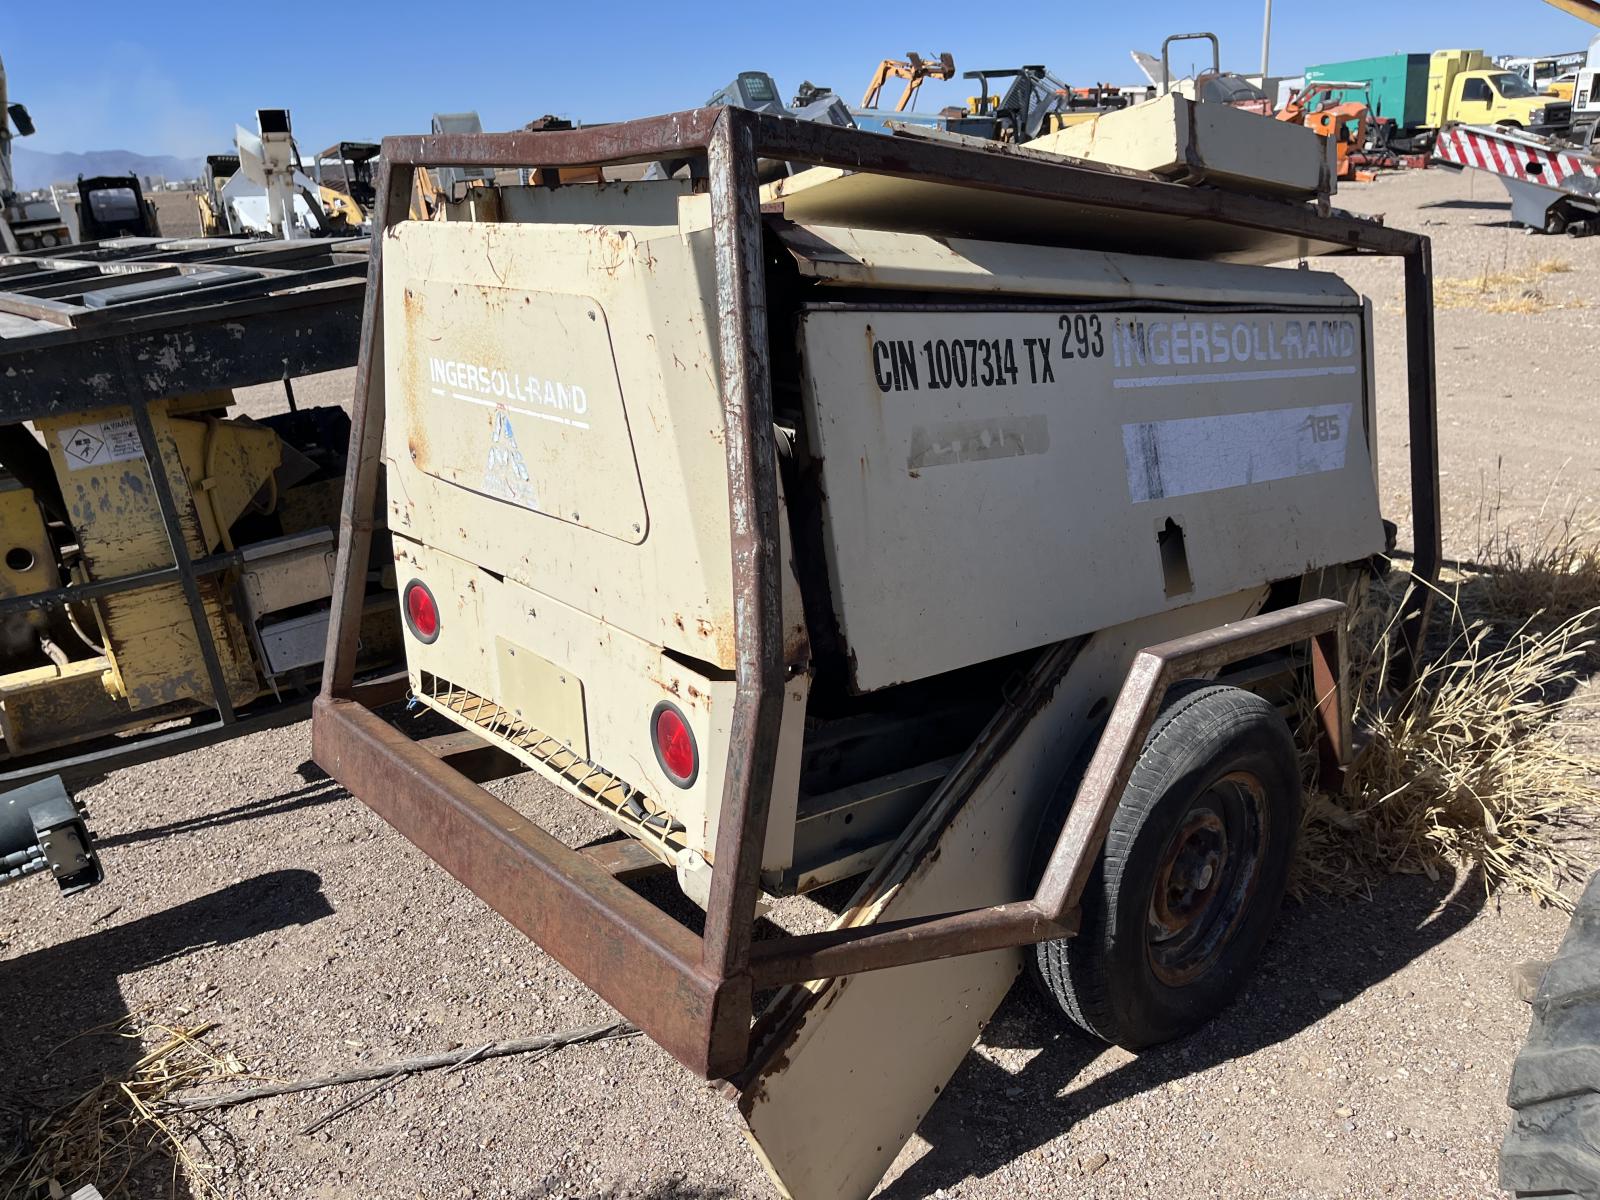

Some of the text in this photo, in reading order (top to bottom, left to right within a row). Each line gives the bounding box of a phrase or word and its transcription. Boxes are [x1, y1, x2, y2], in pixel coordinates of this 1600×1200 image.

[1059, 314, 1104, 359] 293
[1112, 320, 1355, 367] INGERSOLL-RAND
[429, 358, 588, 414] INGERSOLL-RAND
[873, 338, 1055, 392] CIN 1007314 TX
[1308, 415, 1341, 442] 185
